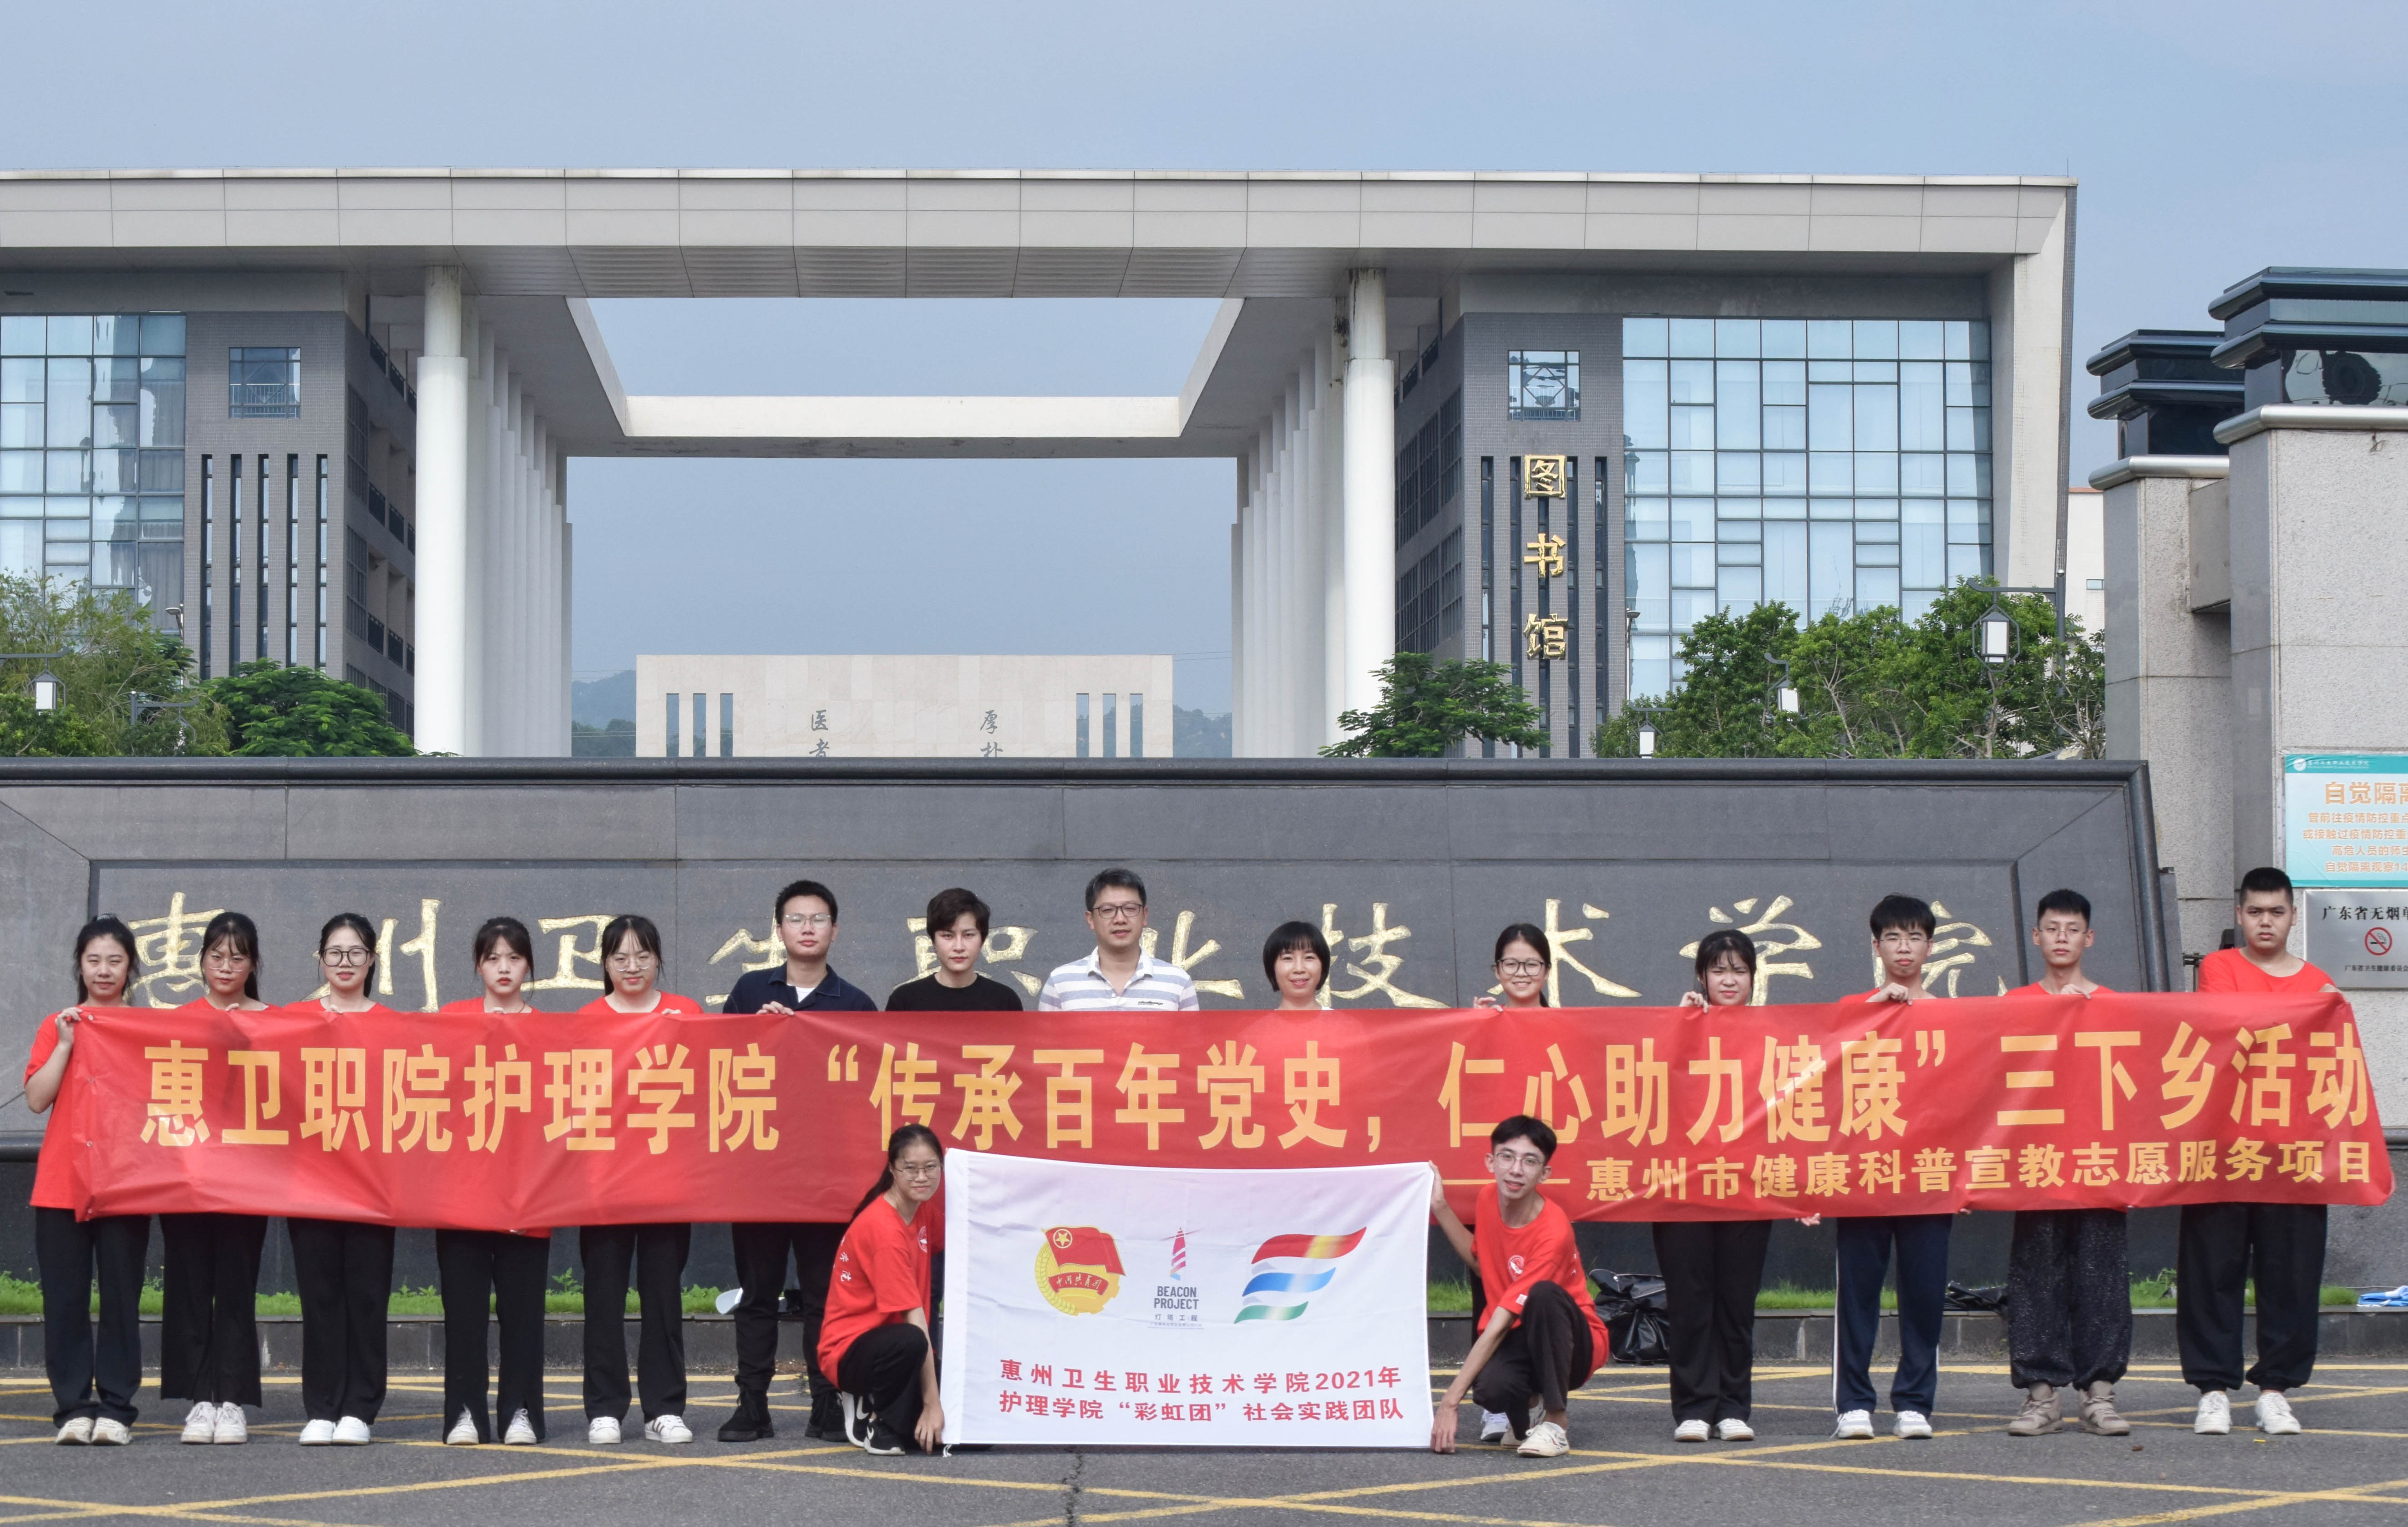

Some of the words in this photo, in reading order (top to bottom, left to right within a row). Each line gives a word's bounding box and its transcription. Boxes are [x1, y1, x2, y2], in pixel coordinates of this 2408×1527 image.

[1524, 454, 1568, 660] 图书馆
[1157, 1286, 1197, 1298] BEACON
[1154, 1298, 1199, 1310] PROJECT
[1000, 1359, 1401, 1394] 惠州卫生职业技术学院2021年
